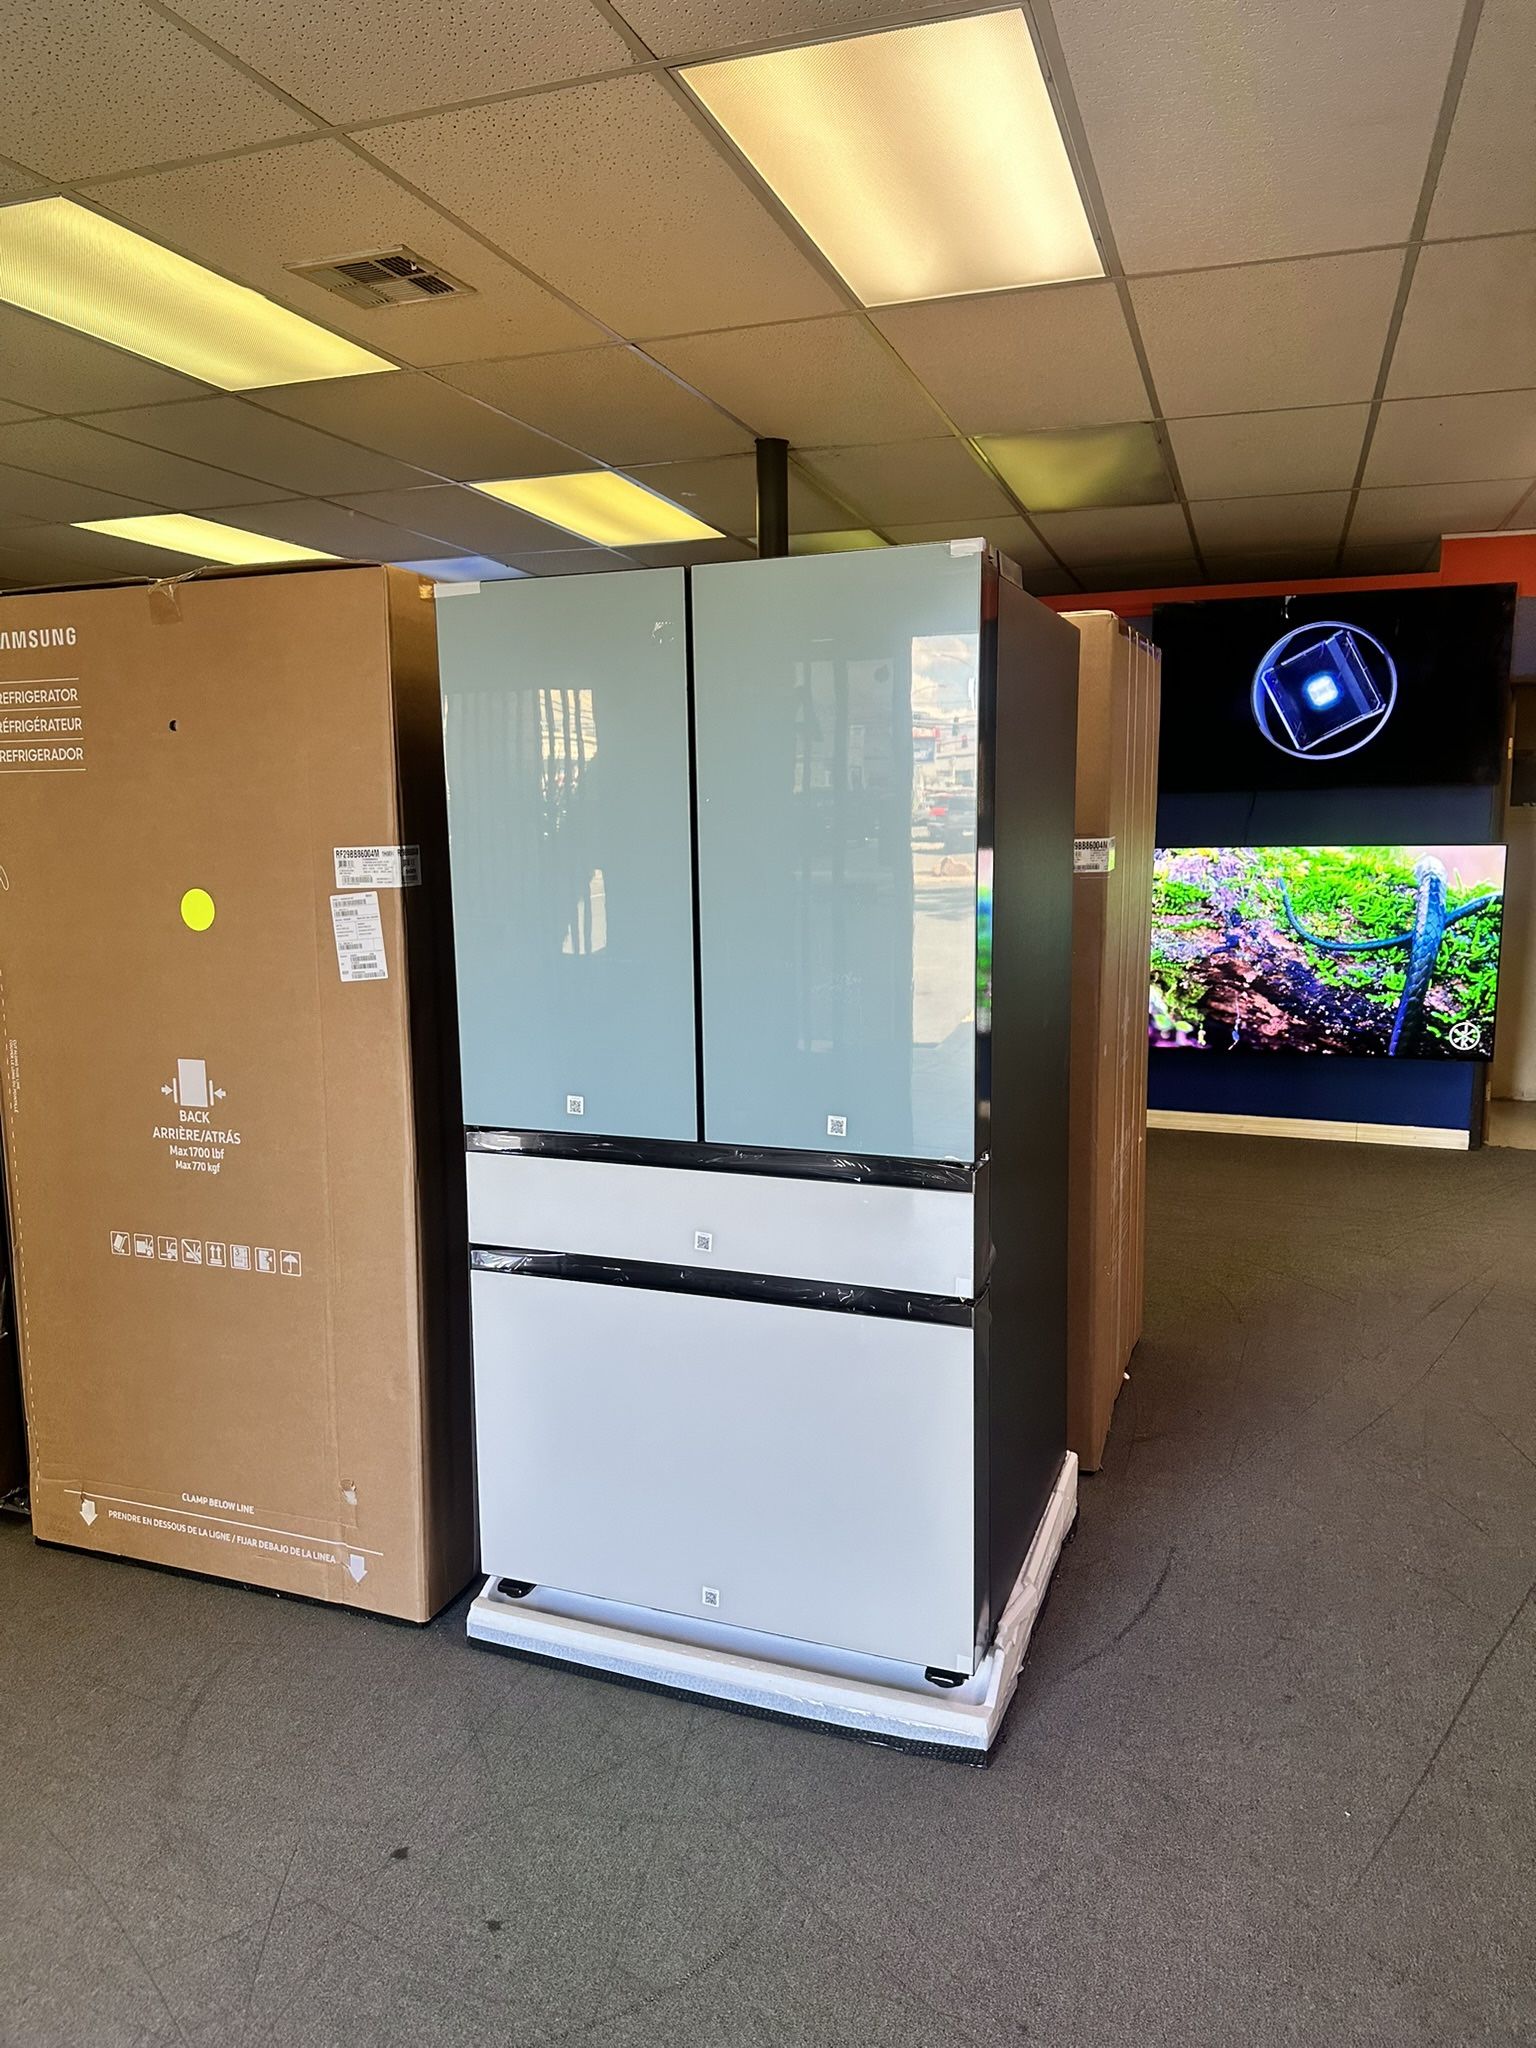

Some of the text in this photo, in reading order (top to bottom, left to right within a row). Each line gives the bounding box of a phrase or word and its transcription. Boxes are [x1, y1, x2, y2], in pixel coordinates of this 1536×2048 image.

[0, 627, 77, 649] AMSUNG
[0, 747, 83, 762] REFRIGERADOR
[179, 1109, 210, 1123] BACK
[152, 1126, 241, 1145] ARRIÈRE/ATRÁS
[169, 1145, 225, 1160] Max 1700 lbf
[175, 1160, 221, 1175] Max 770 kgf
[181, 1492, 255, 1515] CLAMP BELOW LINE
[108, 1509, 142, 1524] PRENDRE
[142, 1516, 153, 1526] EN
[153, 1518, 187, 1533] DESSOUS
[187, 1526, 197, 1535] DE
[198, 1527, 208, 1537] LA
[209, 1530, 231, 1543] LIGNE
[236, 1535, 258, 1547] FIJAR
[258, 1540, 289, 1554] DEBAJO
[289, 1547, 301, 1557] DE
[301, 1549, 312, 1559] LA
[312, 1551, 337, 1564] LINEA
